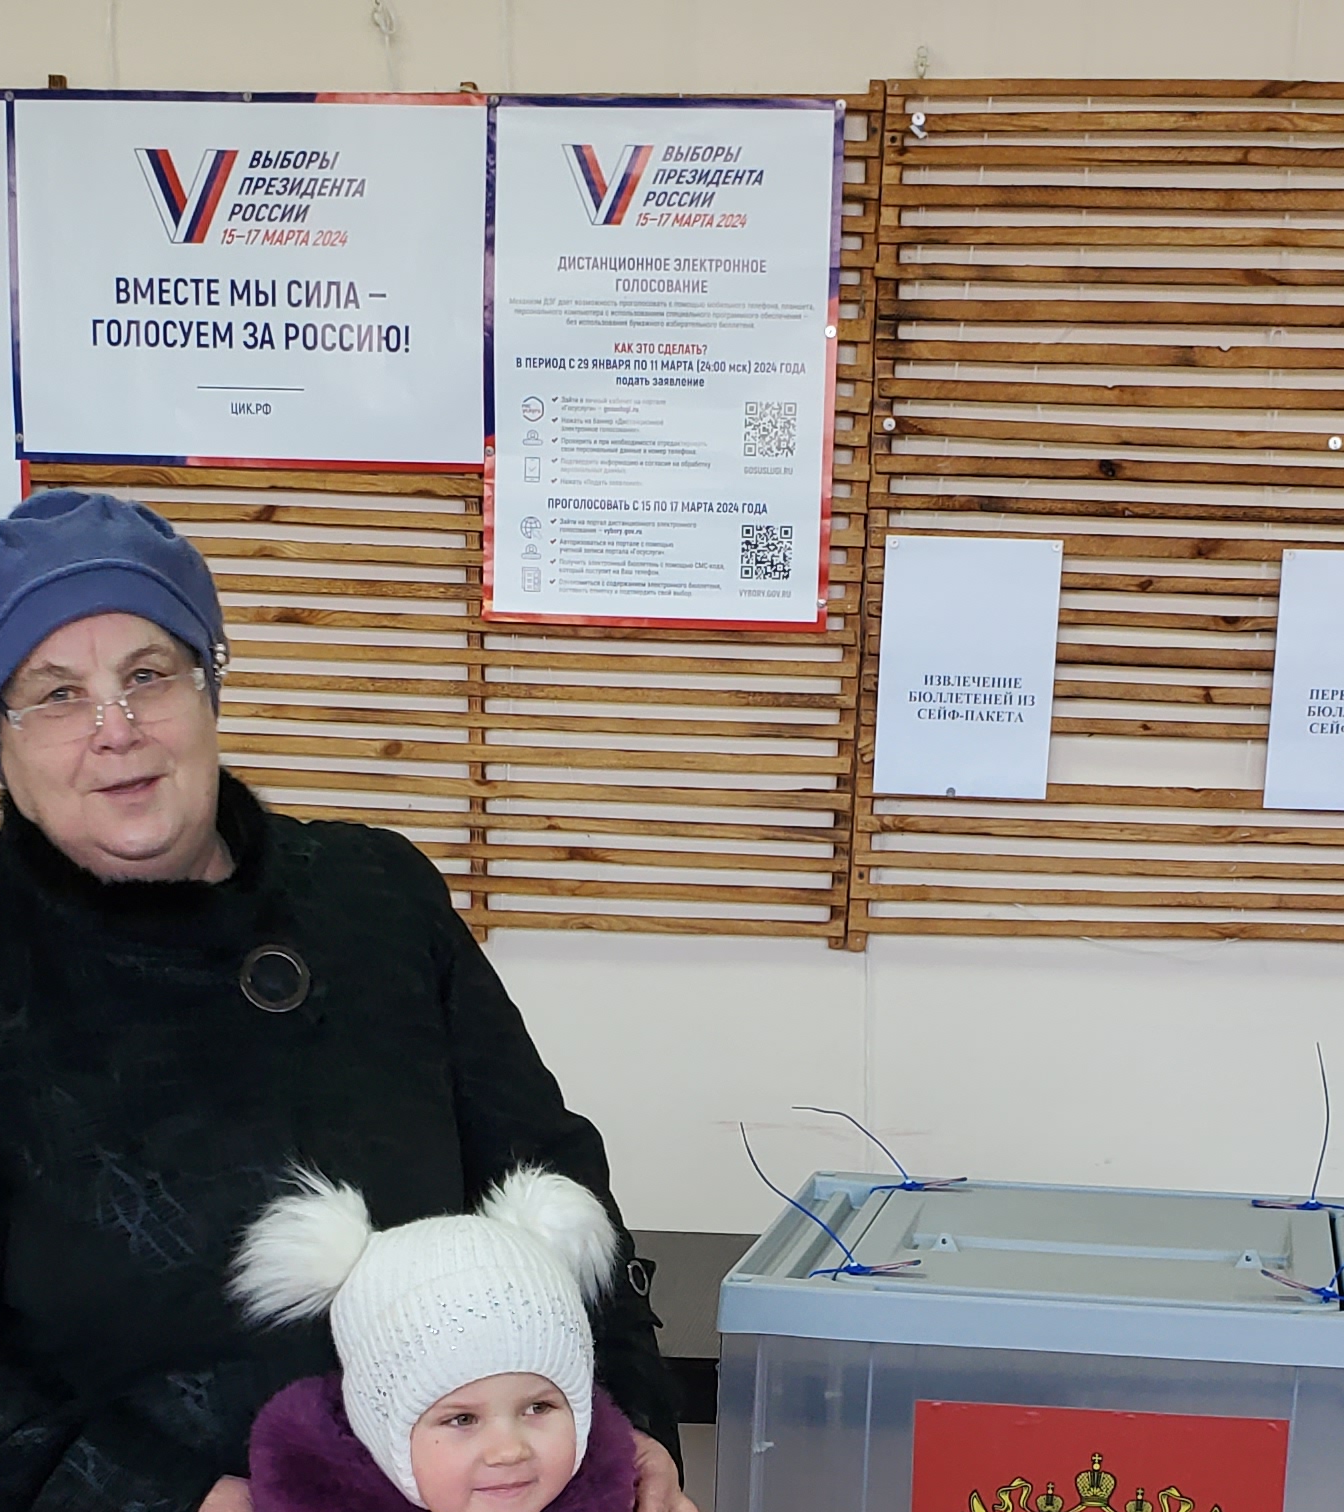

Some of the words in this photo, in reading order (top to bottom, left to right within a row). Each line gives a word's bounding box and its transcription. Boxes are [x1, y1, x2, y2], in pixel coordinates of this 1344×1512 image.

[248, 151, 339, 169] ВЫБОРЫ
[662, 146, 742, 162] ВЫБОРЫ
[653, 169, 764, 187] ПРЕЗИДЕНТА
[238, 177, 365, 198] ПРЕЗИДЕНТА
[643, 191, 715, 207] РОССИИ
[228, 203, 310, 222] РОССИИ
[671, 213, 714, 227] МАРТА
[716, 214, 747, 228] 2024
[261, 229, 310, 246] МАРТА
[312, 230, 348, 246] 2024
[558, 256, 670, 271] ДИСТАНЦИОННОЕ
[674, 258, 767, 273] ЭЛЕКТРОННОЕ
[116, 277, 219, 305] ВМЕСТЕ
[230, 279, 276, 307] МЫ
[287, 280, 359, 308] СИЛА
[616, 278, 708, 293] ГОЛОСОВАНИЕ
[92, 319, 233, 348] ГОЛОСУЕМ
[243, 322, 275, 349] ЗА
[285, 323, 409, 352] РОССИЮ!
[615, 343, 633, 353] КАК
[636, 343, 654, 354] ЭТО
[658, 344, 707, 355] СДЕЛАТЬ?
[516, 357, 522, 367] В
[526, 358, 566, 370] ПЕРИОД
[569, 358, 575, 369] С
[578, 358, 588, 369] 29
[592, 359, 630, 369] ЯНВАРЯ
[634, 360, 647, 370] ПО
[651, 360, 657, 370] 11
[661, 360, 693, 371] МАРТА
[697, 360, 726, 373] (24:00
[729, 360, 751, 374] мск)
[754, 362, 777, 373] 2024
[780, 363, 805, 375] ГОДА
[616, 377, 650, 386] подать
[653, 378, 704, 387] заявление
[231, 403, 271, 415] ЦИК.РФ
[548, 498, 630, 510] ПРОГОЛОСОВАТЬ
[633, 500, 639, 510] С
[642, 501, 651, 511] 15
[654, 501, 667, 511] ПО
[670, 501, 678, 512] 17
[682, 502, 714, 512] МАРТА
[716, 502, 739, 513] 2024
[742, 503, 767, 515] ГОДА
[921, 675, 1021, 692] ИЗВЛЕЧЕНИЕ
[909, 687, 1015, 707] БЮЛЛЕТЕНЕЙ
[1018, 695, 1035, 706] ИЗ
[918, 703, 1025, 722] СЕЙФ-ПАКЕТА
